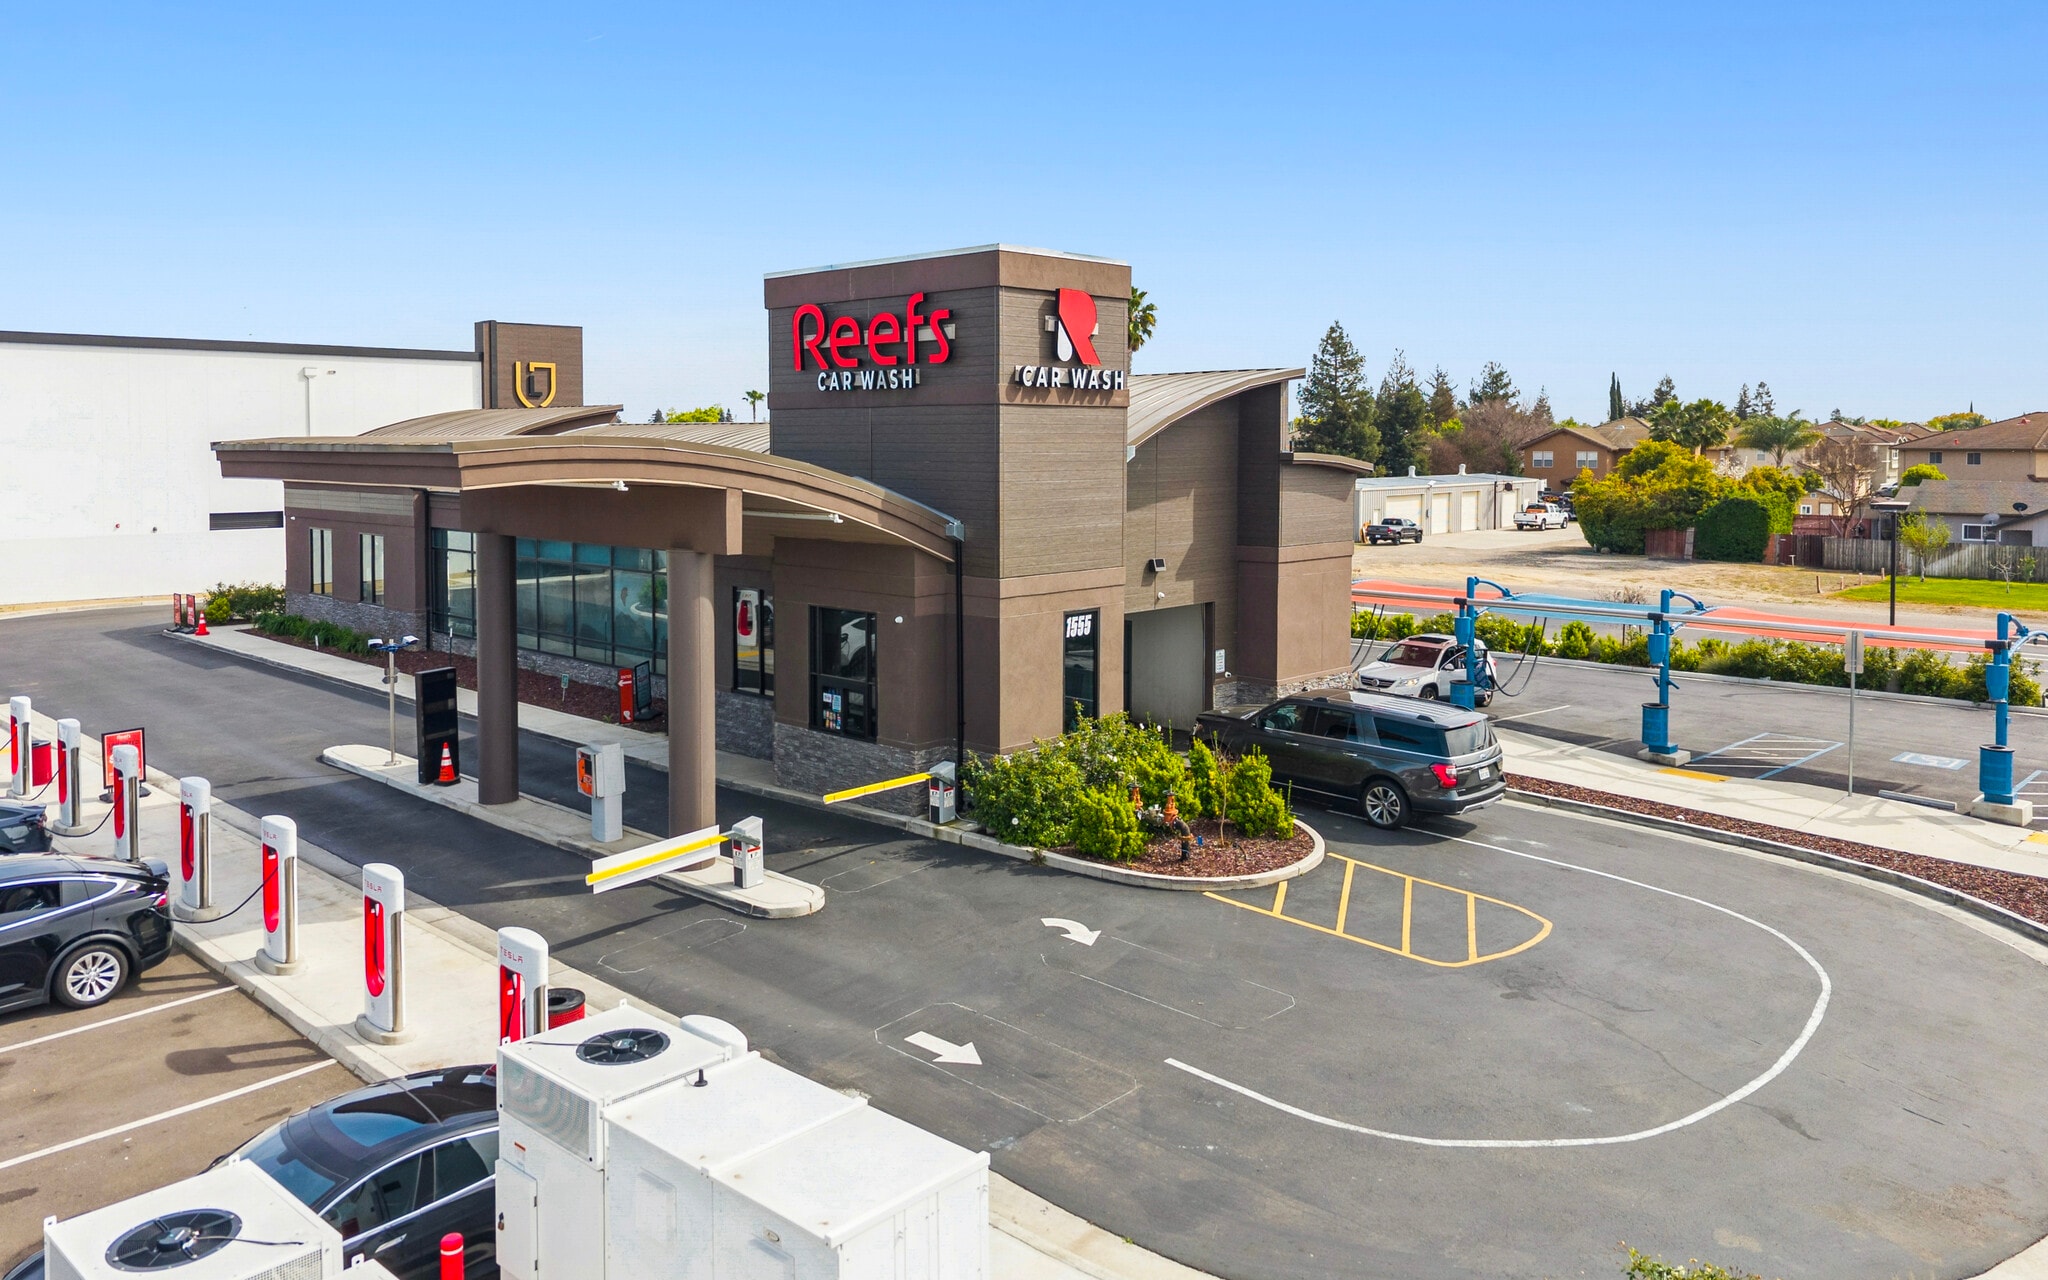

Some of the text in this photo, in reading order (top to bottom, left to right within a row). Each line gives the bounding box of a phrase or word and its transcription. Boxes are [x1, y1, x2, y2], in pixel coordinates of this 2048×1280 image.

[792, 291, 950, 371] Reefs
[817, 368, 913, 391] CAR WASH
[1022, 365, 1124, 390] CAR WASH
[1065, 613, 1092, 638] 1555
[500, 945, 524, 963] TESLA
